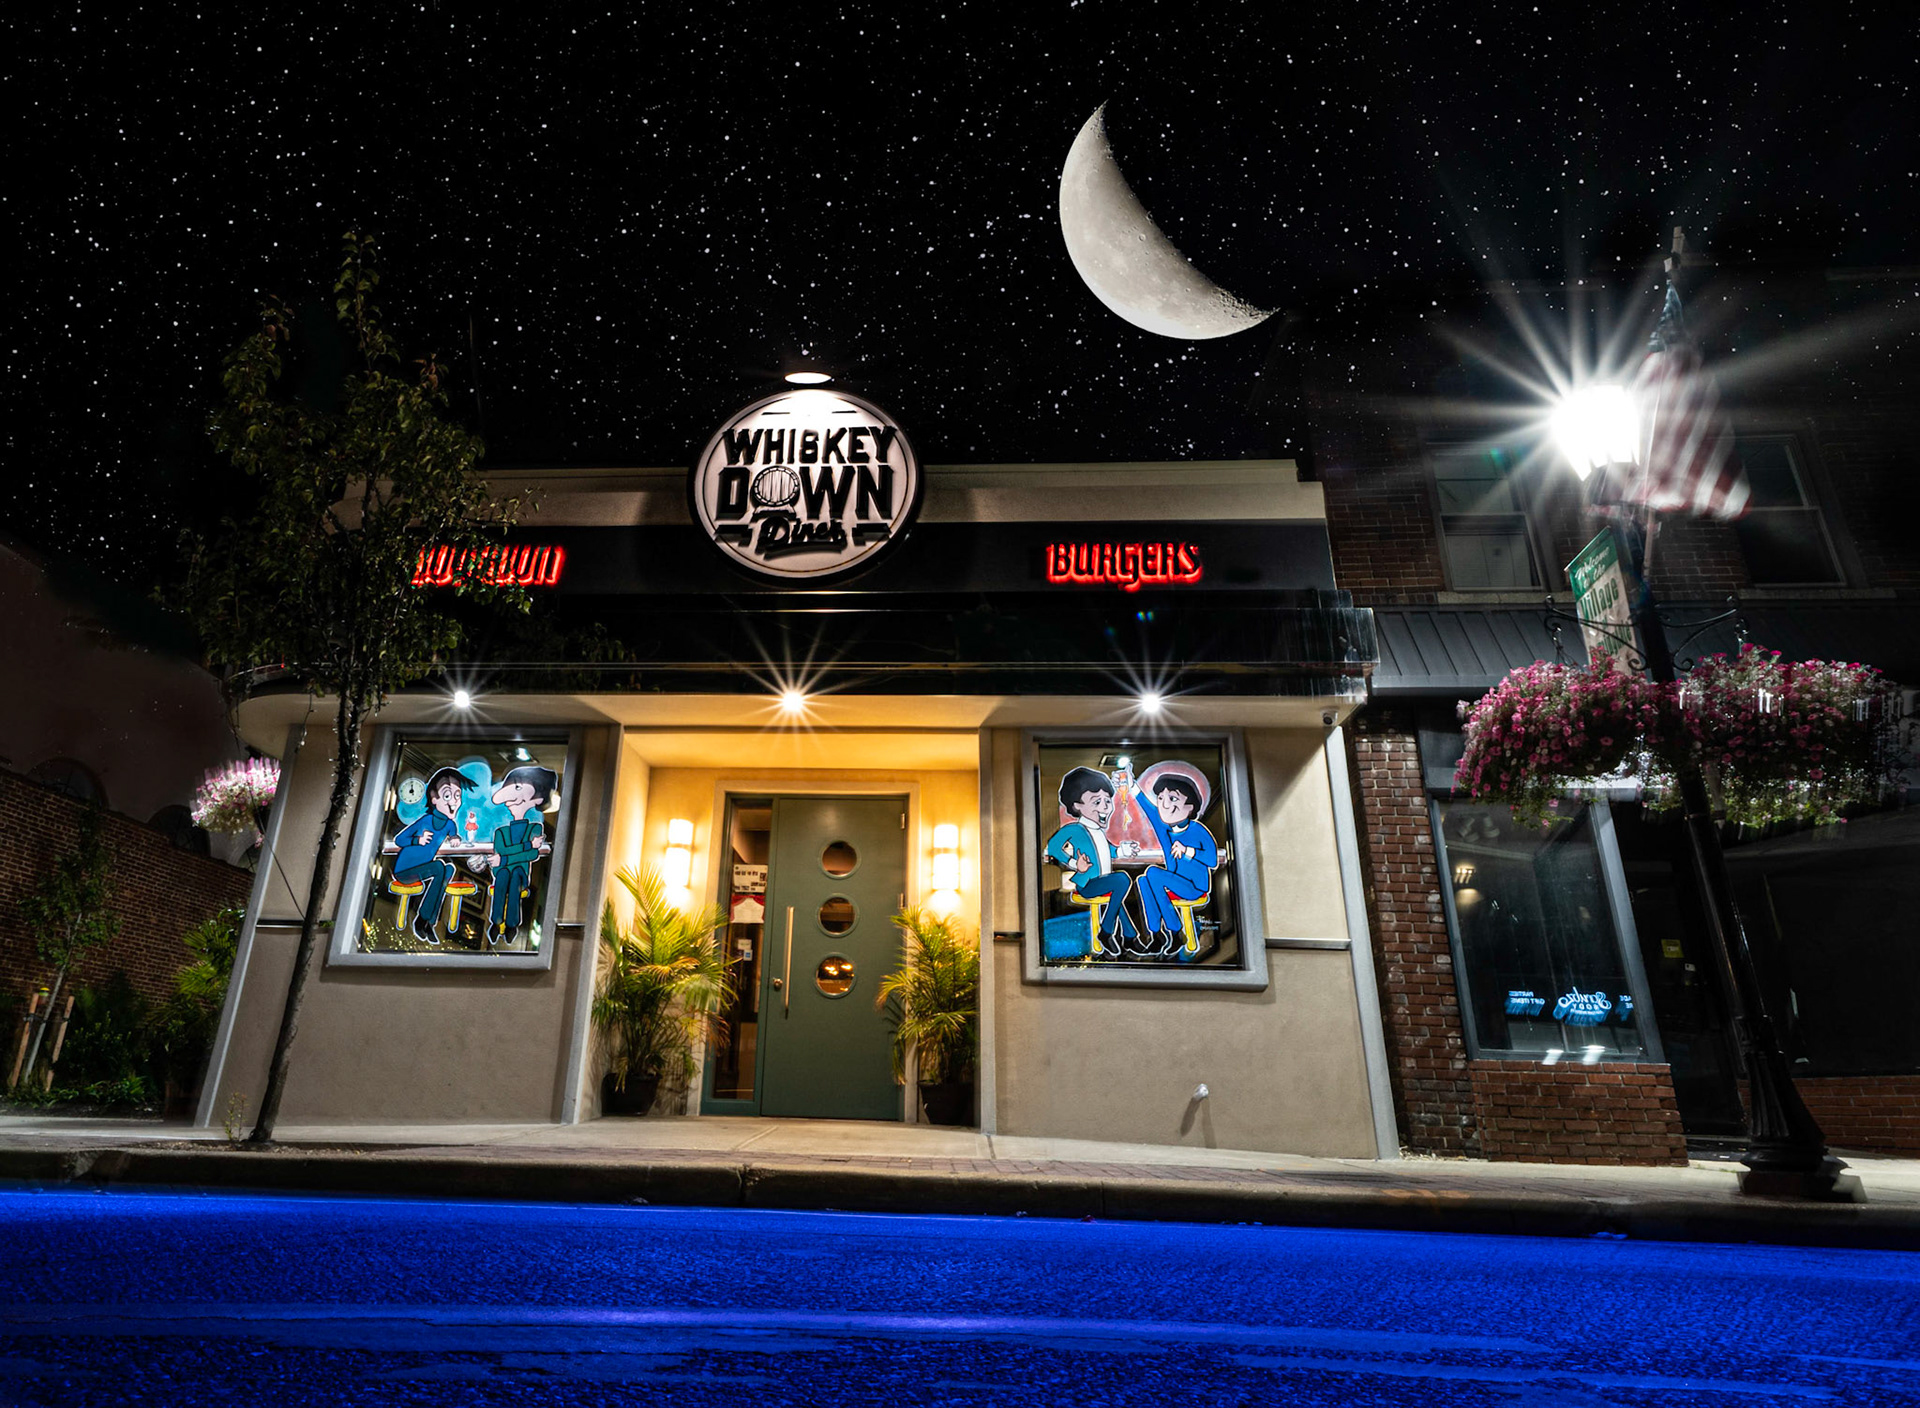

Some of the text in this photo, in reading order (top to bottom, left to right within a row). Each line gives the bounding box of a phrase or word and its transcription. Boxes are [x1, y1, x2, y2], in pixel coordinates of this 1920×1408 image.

[723, 425, 896, 465] WHISKEY
[715, 464, 894, 522] DOWN
[755, 514, 849, 560] Diner
[1046, 541, 1203, 592] BURGERS
[1580, 577, 1619, 619] Village
